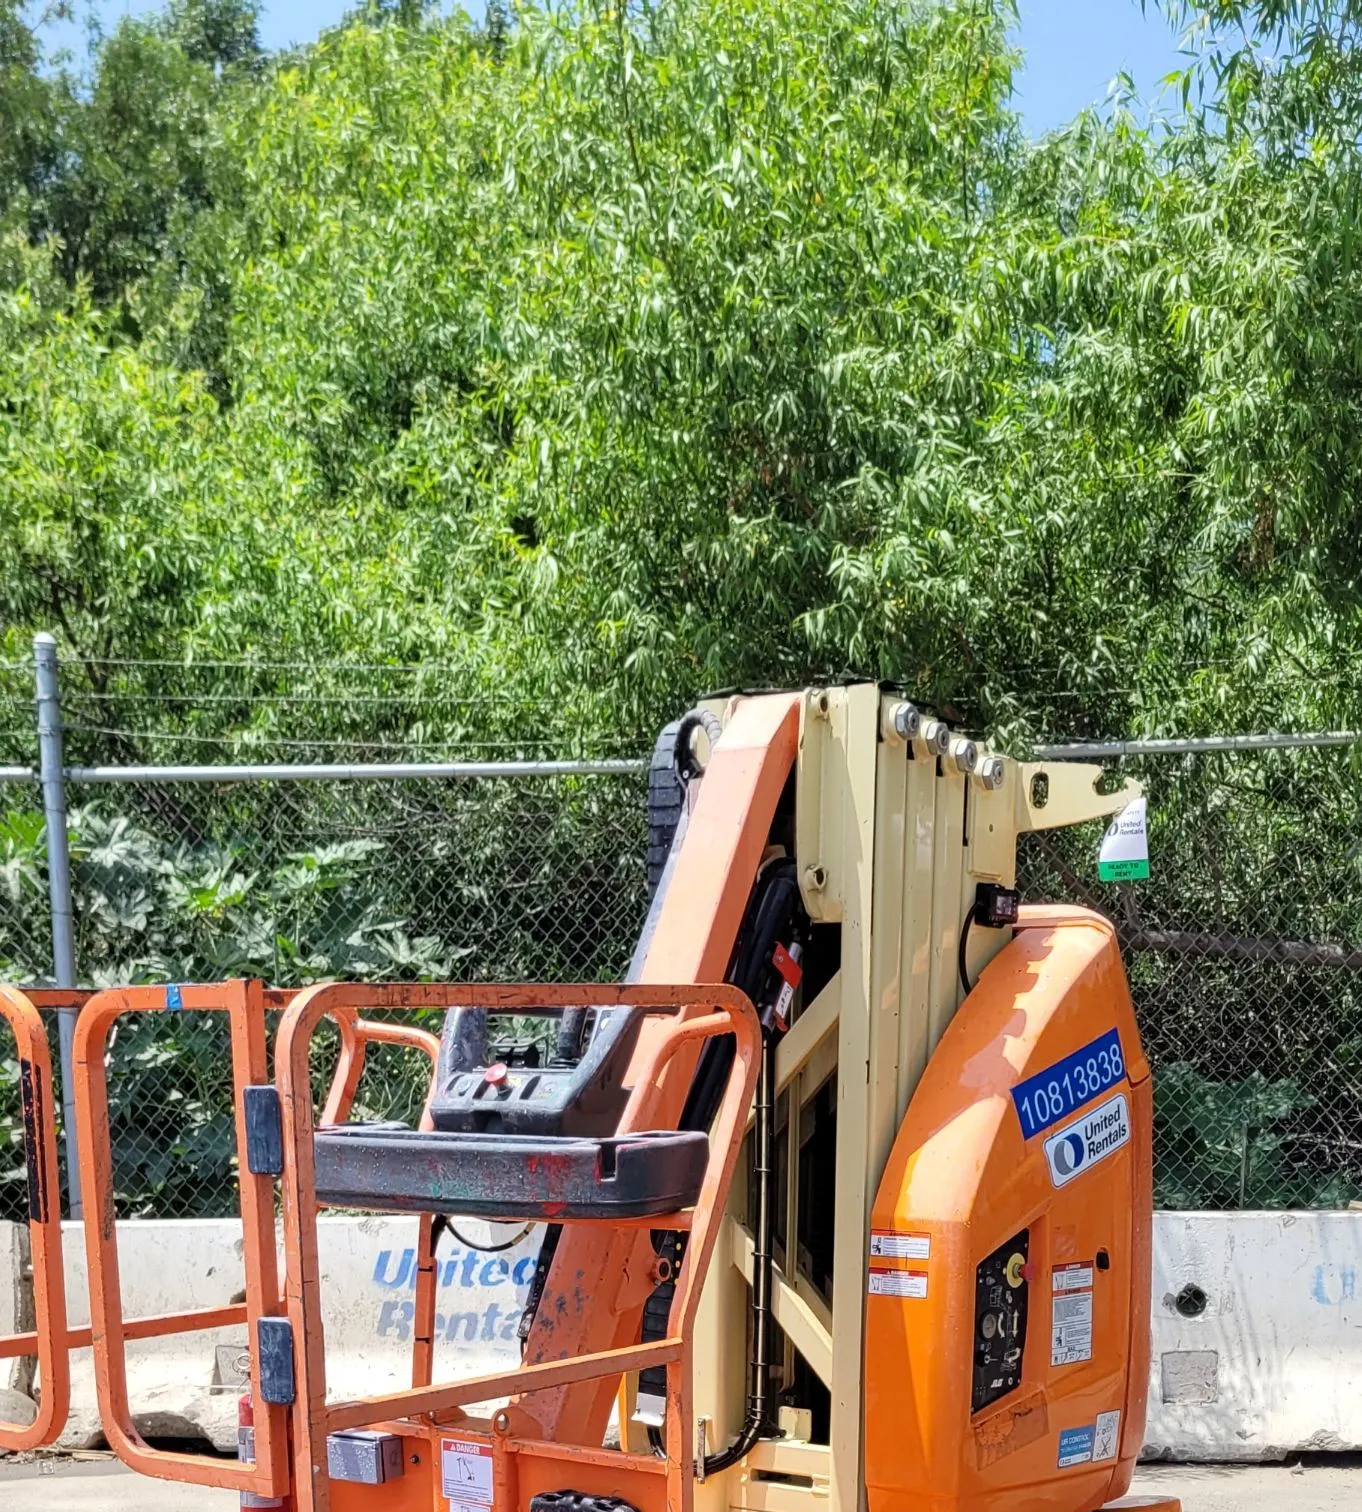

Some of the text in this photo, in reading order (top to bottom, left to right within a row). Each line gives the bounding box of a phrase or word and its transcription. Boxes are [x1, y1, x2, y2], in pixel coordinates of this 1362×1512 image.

[1120, 820, 1141, 828] United
[1021, 1044, 1122, 1130] 10813838
[1084, 1104, 1121, 1140] United
[1088, 1123, 1127, 1159] Rentals
[456, 1443, 480, 1455] DANGER
